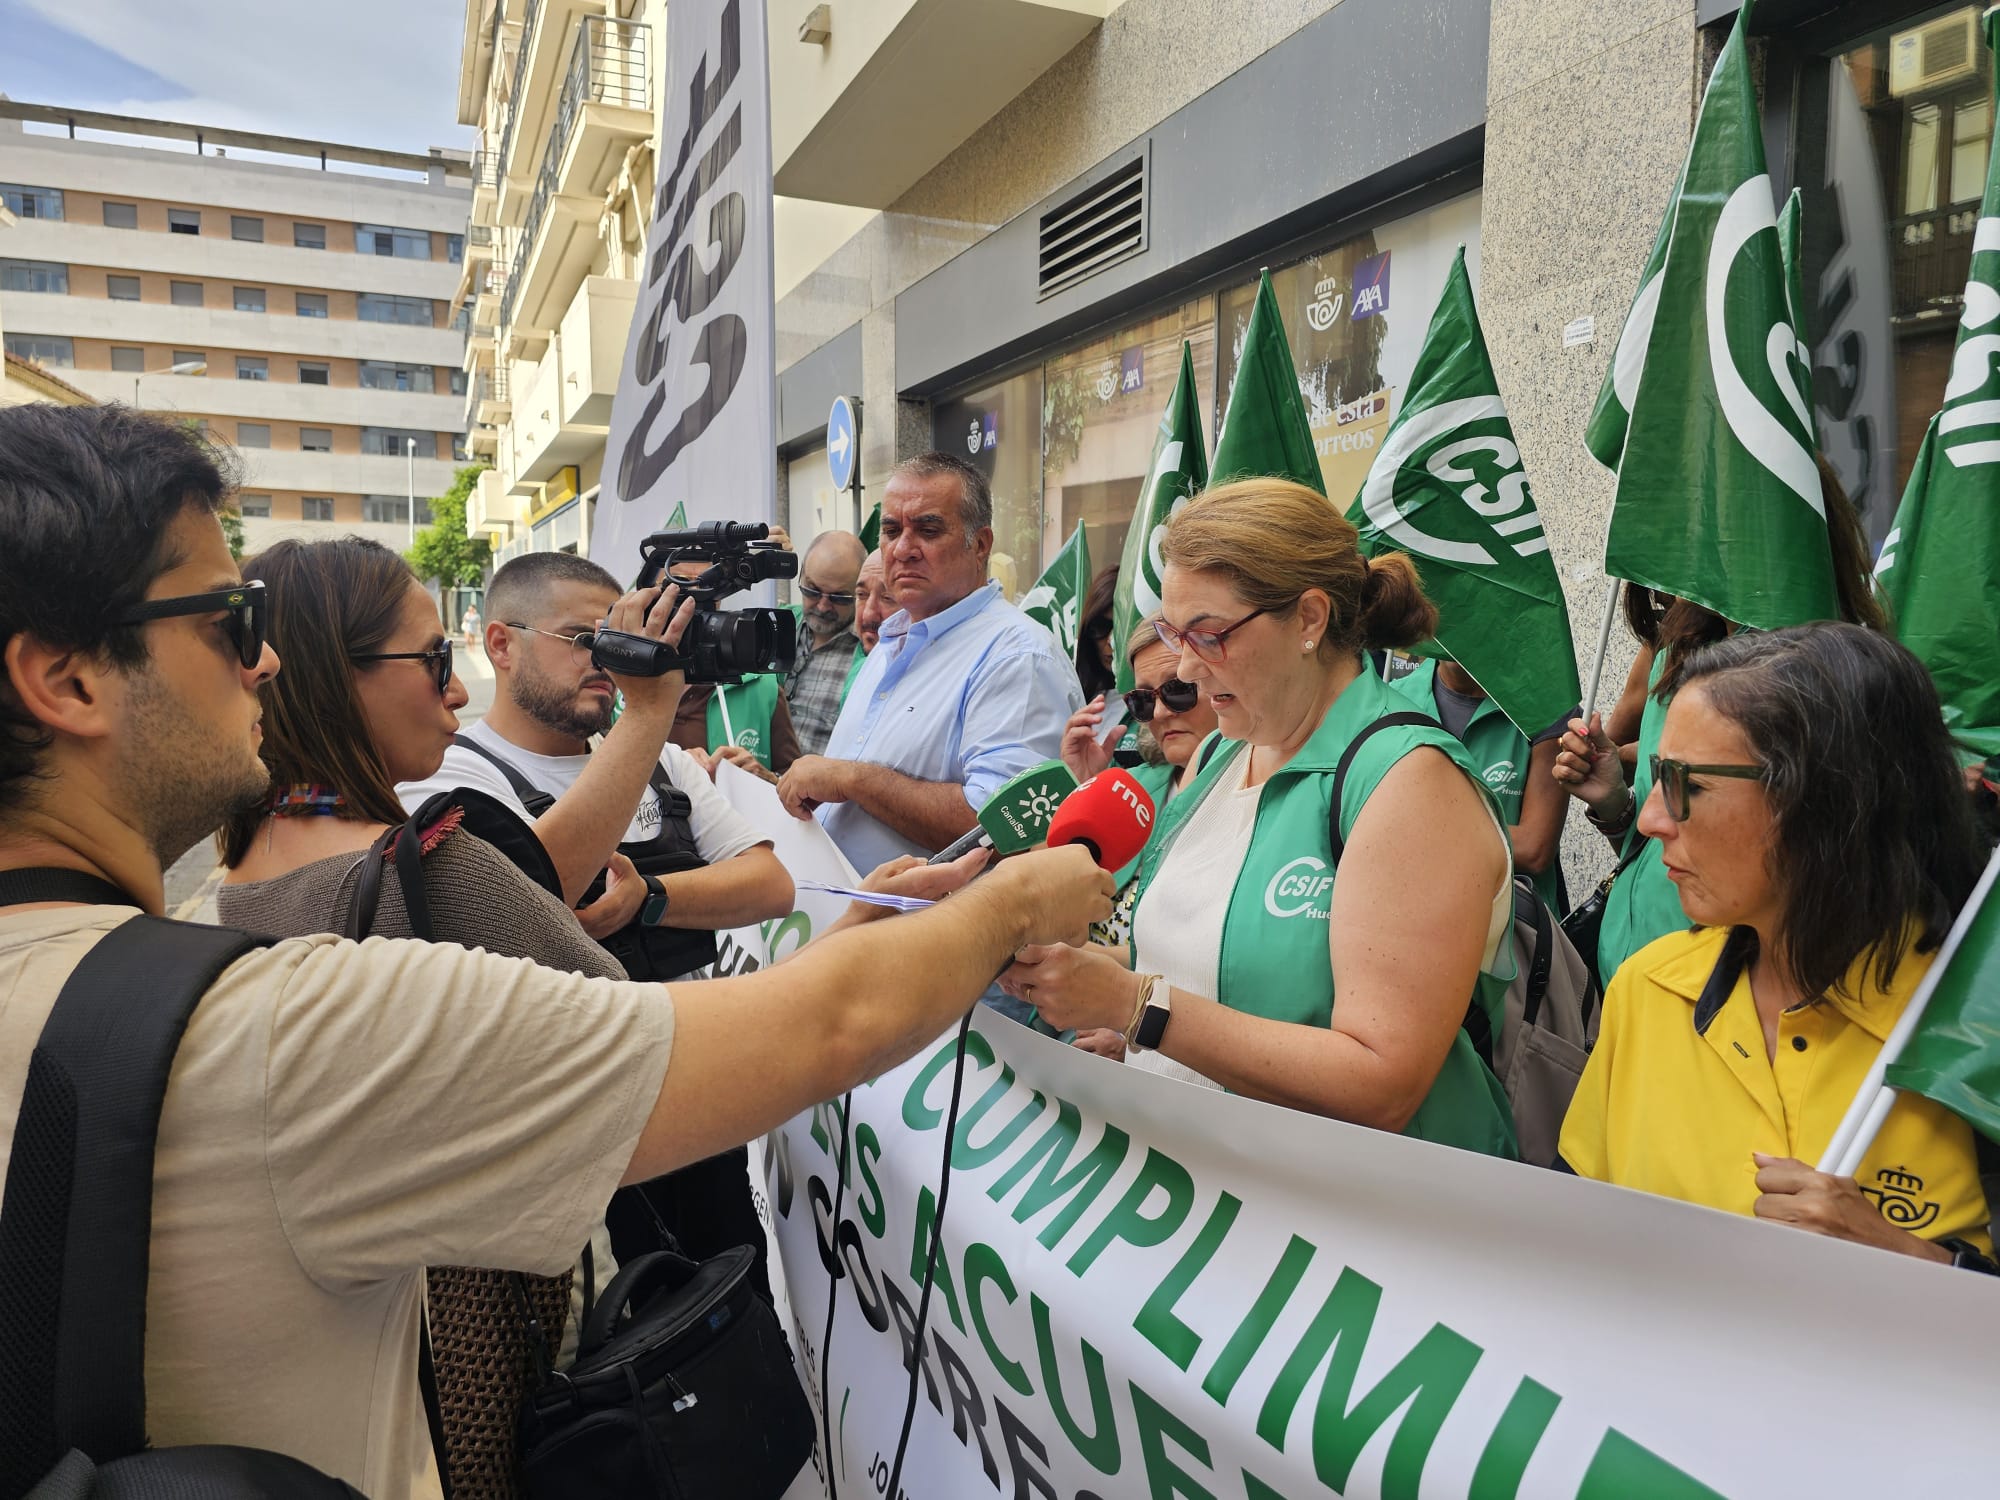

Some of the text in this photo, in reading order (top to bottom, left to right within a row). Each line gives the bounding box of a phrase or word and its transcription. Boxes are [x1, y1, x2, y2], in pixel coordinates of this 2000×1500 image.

[1351, 283, 1384, 316] AXA
[1121, 368, 1141, 391] AXA
[1336, 391, 1376, 422] está
[1313, 427, 1375, 457] orreos
[606, 645, 637, 658] SONY
[1486, 770, 1518, 783] CSIF
[1111, 780, 1151, 828] rne
[1278, 873, 1335, 898] CSIF
[902, 1029, 1735, 1500] CUMPLIMI
[807, 1174, 1105, 1500] CORRE
[909, 1184, 1290, 1500] ACUE
